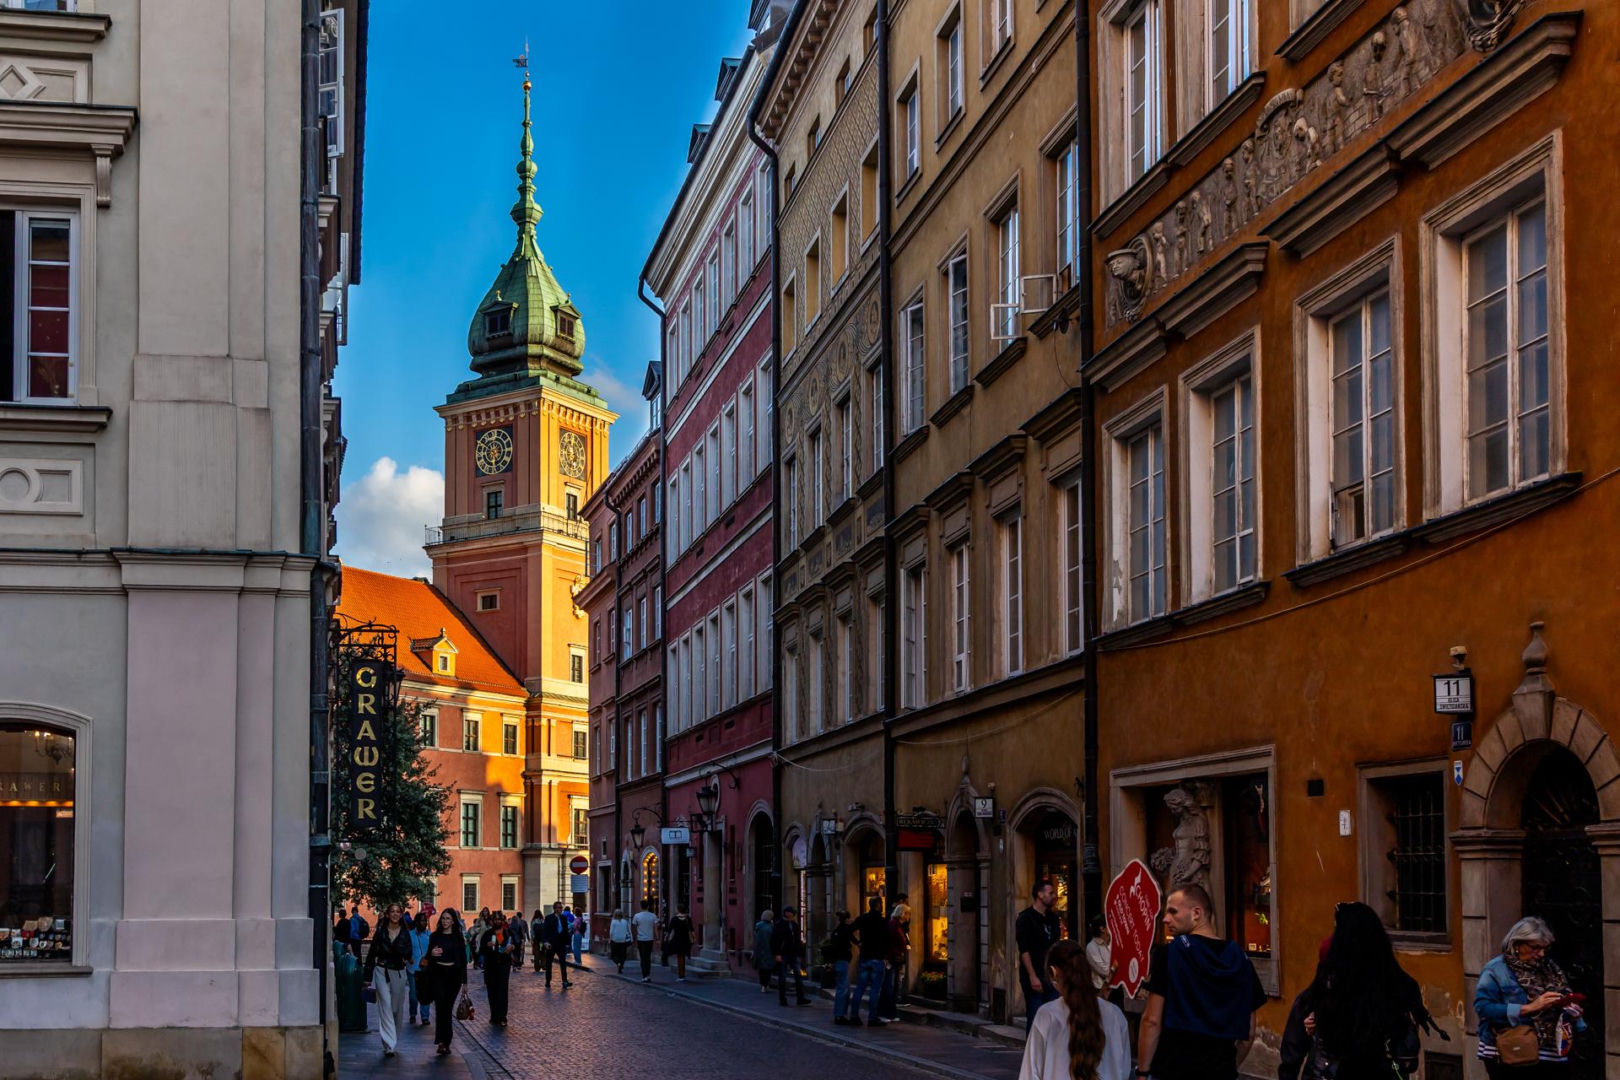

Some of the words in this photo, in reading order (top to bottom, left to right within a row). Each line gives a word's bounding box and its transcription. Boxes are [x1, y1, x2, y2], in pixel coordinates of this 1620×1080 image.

[1444, 680, 1460, 696] 11
[353, 666, 380, 820] GRAWER
[981, 799, 987, 808] 9
[1135, 884, 1150, 932] CHOPIN
